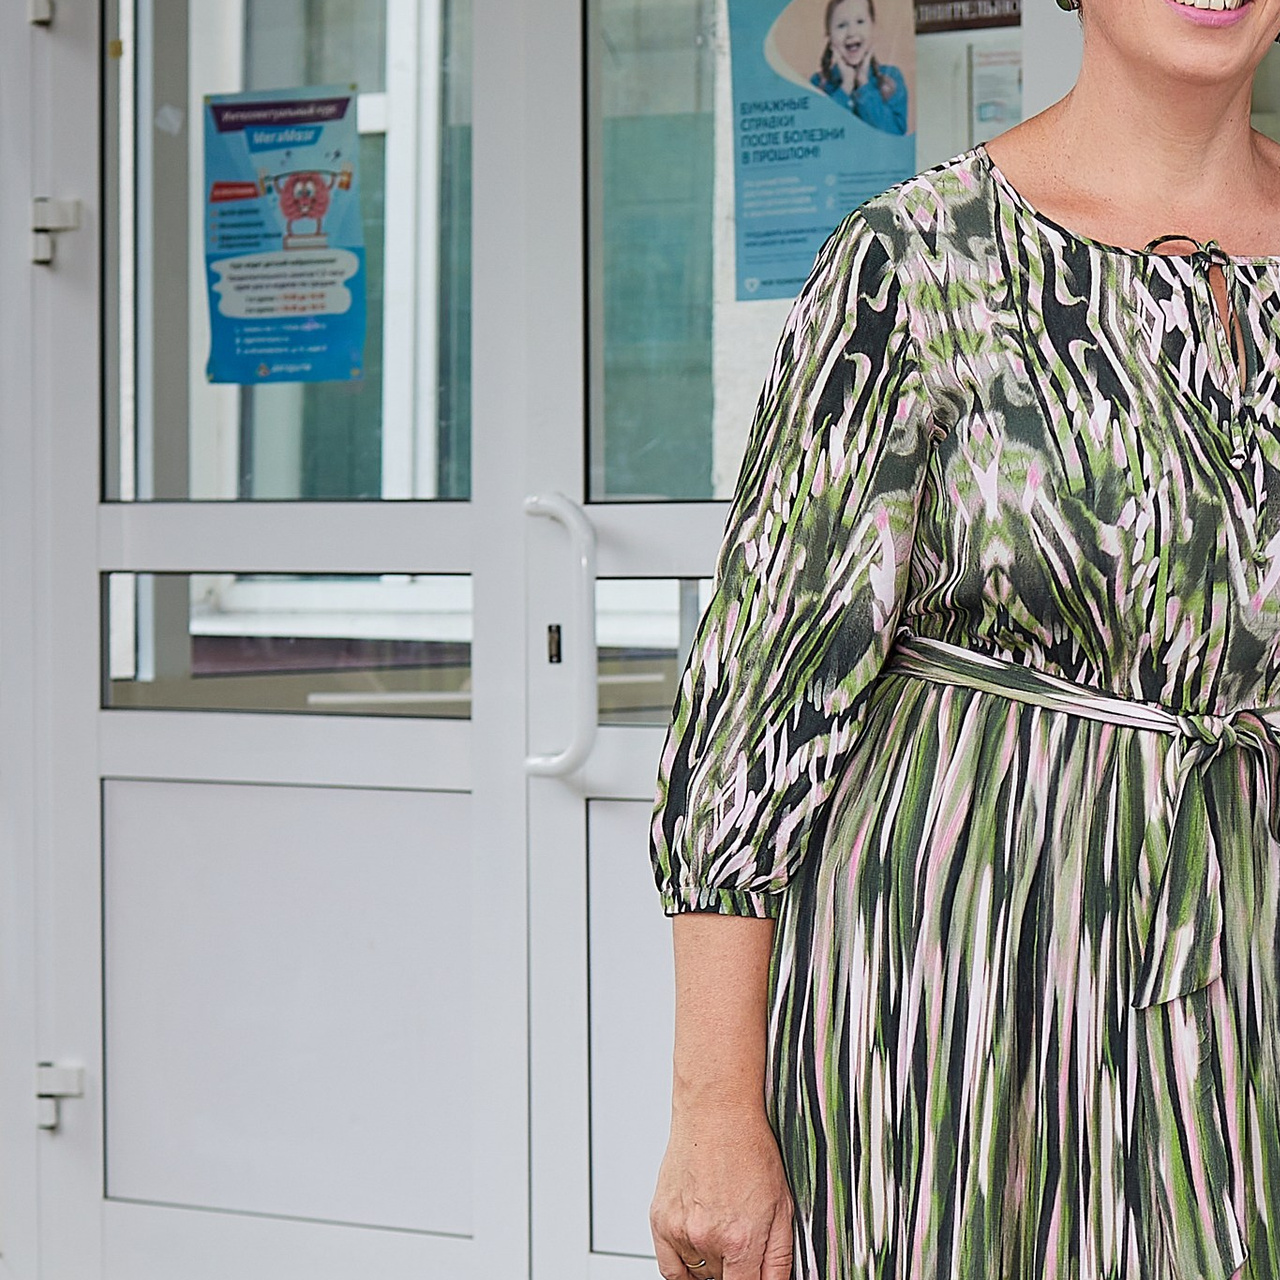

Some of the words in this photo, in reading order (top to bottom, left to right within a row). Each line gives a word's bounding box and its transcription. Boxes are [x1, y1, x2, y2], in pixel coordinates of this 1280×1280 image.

[740, 97, 810, 116] БУМАЖНЫЕ
[740, 116, 795, 132] СПРАВКИ
[741, 131, 780, 148] ПОСЛЕ
[784, 127, 845, 145] БОЛЕЗНИ
[741, 151, 751, 164] В
[753, 146, 821, 164] ПРОШЛОМ!
